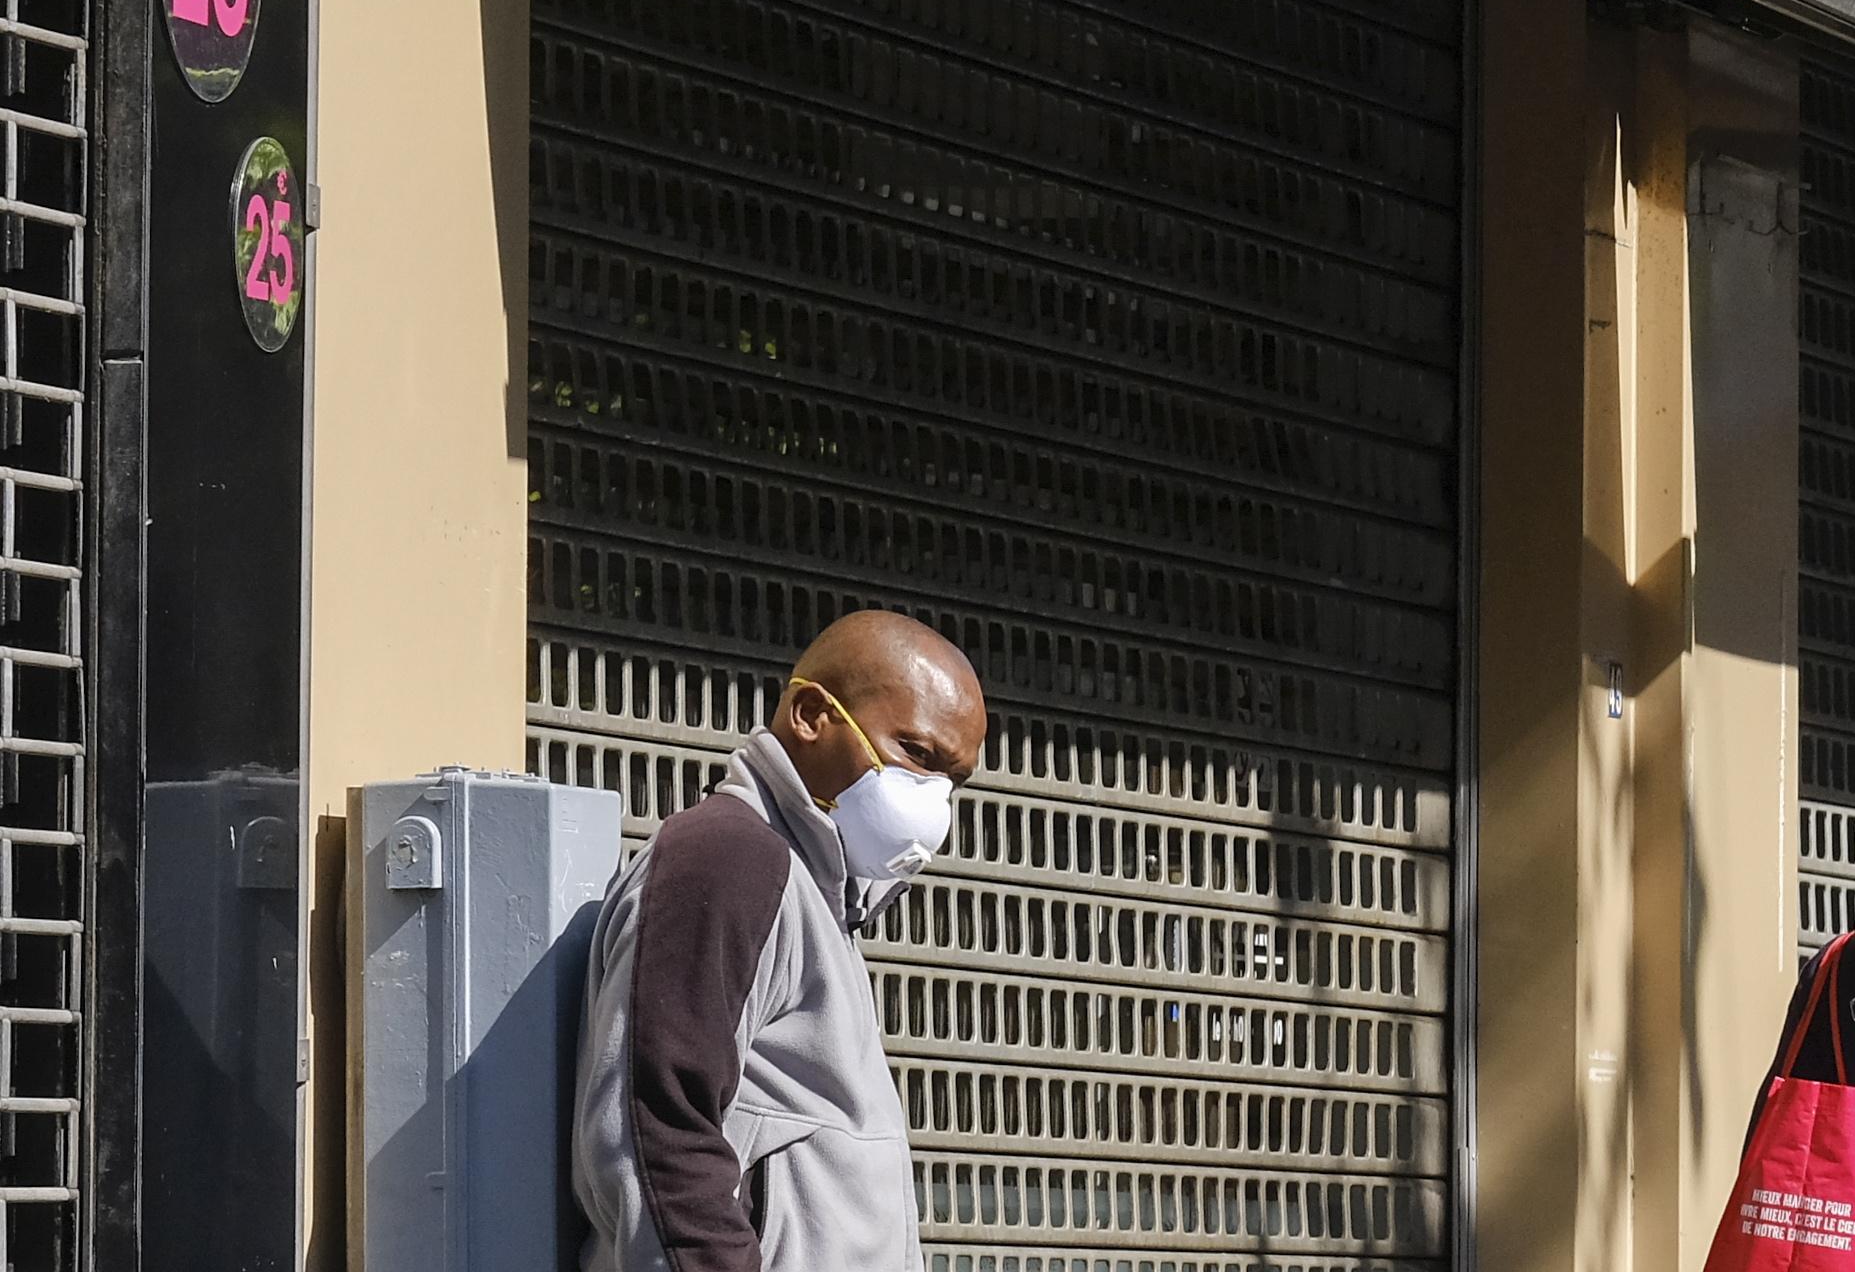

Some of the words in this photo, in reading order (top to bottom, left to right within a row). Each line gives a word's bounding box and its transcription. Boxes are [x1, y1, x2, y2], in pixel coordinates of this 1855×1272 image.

[246, 194, 292, 305] 25
[1825, 1201, 1852, 1217] POUR
[1754, 1223, 1785, 1240] NOTRE
[1824, 1217, 1838, 1231] LE
